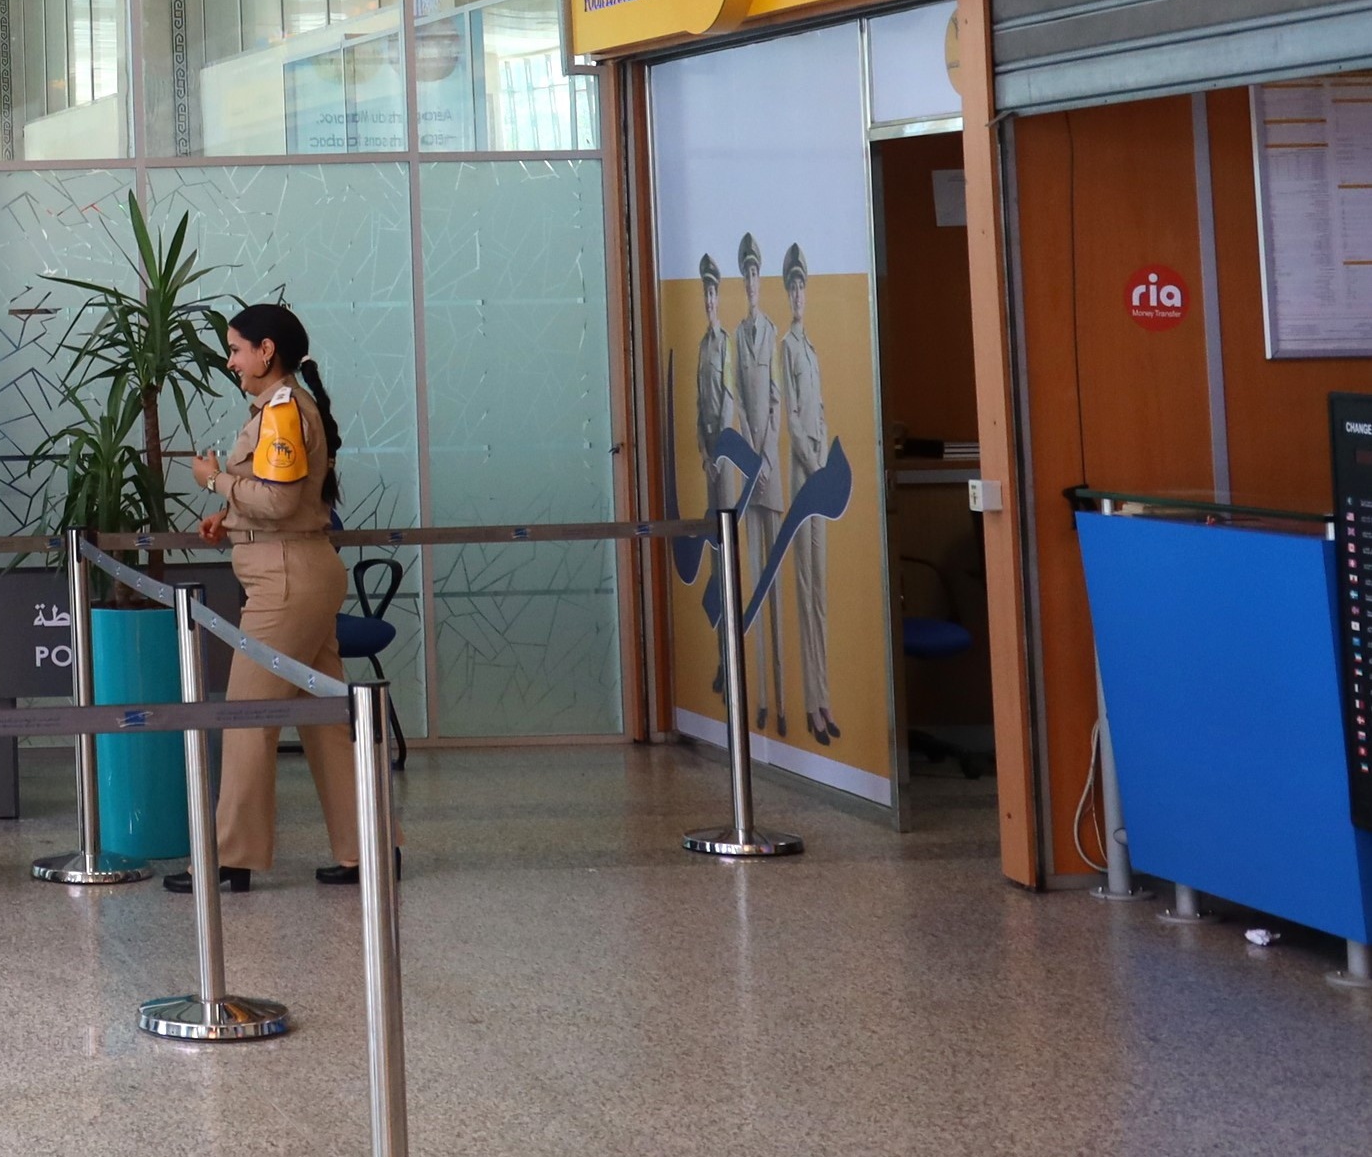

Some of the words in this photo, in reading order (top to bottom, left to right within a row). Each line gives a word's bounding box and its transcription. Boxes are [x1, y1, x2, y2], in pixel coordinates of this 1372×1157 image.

[1132, 272, 1182, 307] ria
[33, 603, 72, 627] طة
[35, 645, 73, 667] PO
